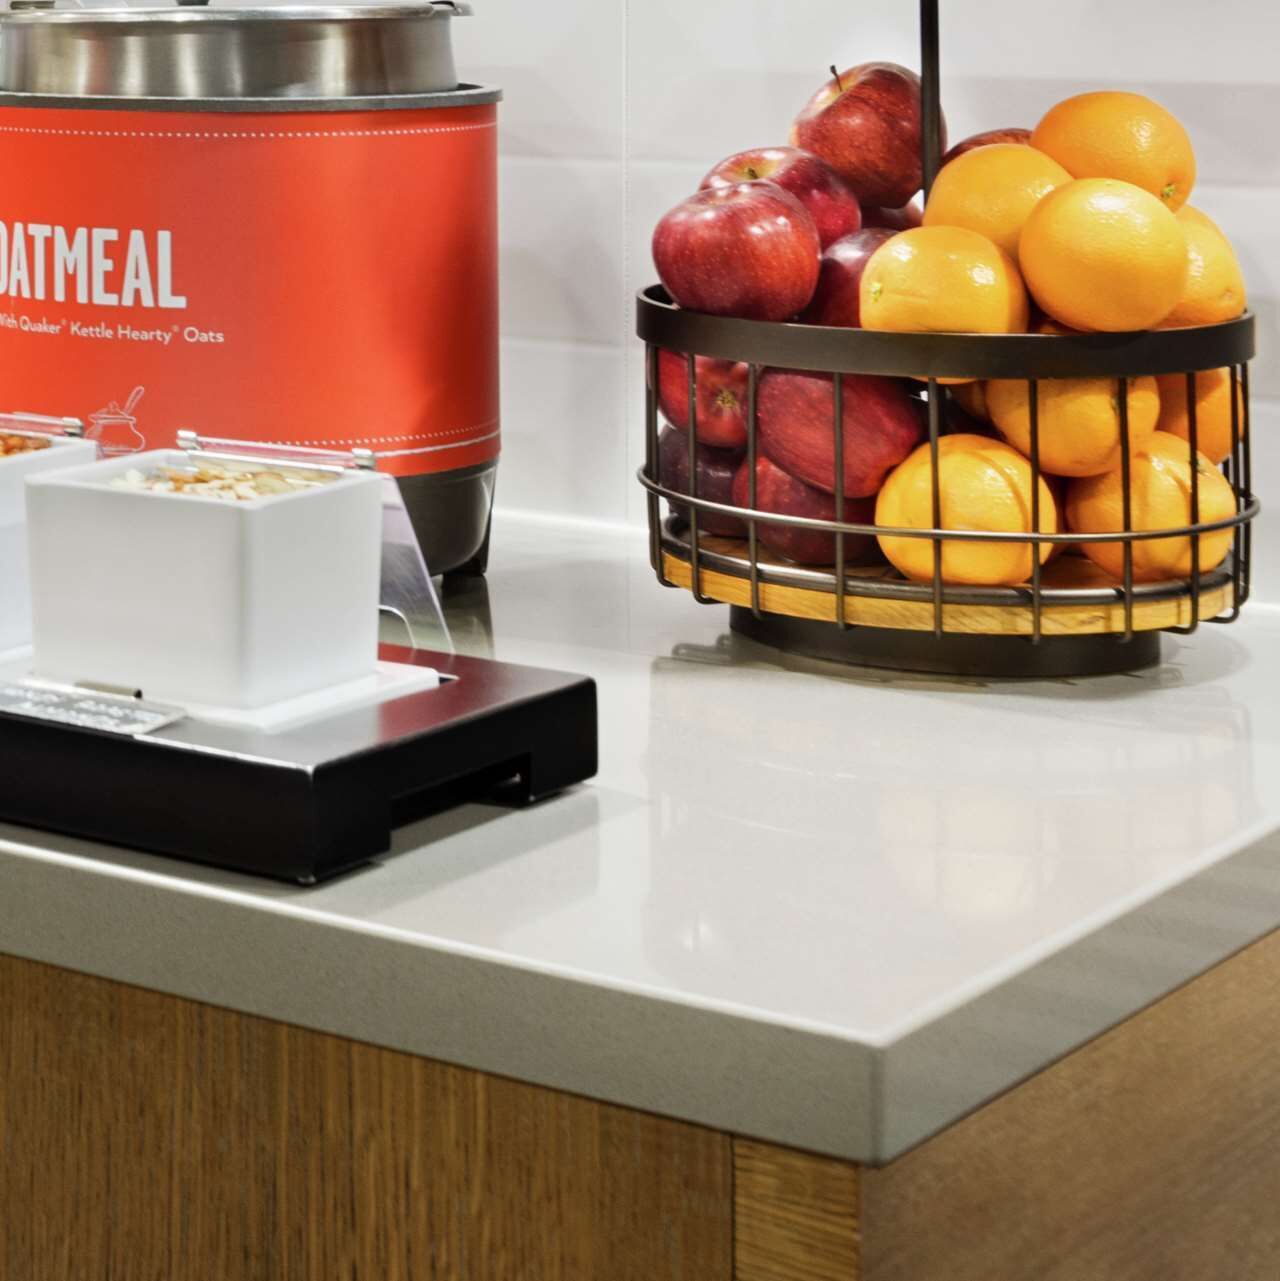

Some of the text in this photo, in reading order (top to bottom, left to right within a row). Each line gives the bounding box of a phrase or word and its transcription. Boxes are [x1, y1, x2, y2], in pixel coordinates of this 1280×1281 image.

[19, 315, 62, 334] Quaker
[70, 322, 113, 339] Kettle
[117, 325, 173, 345] Hearty
[183, 327, 225, 343] Oats
